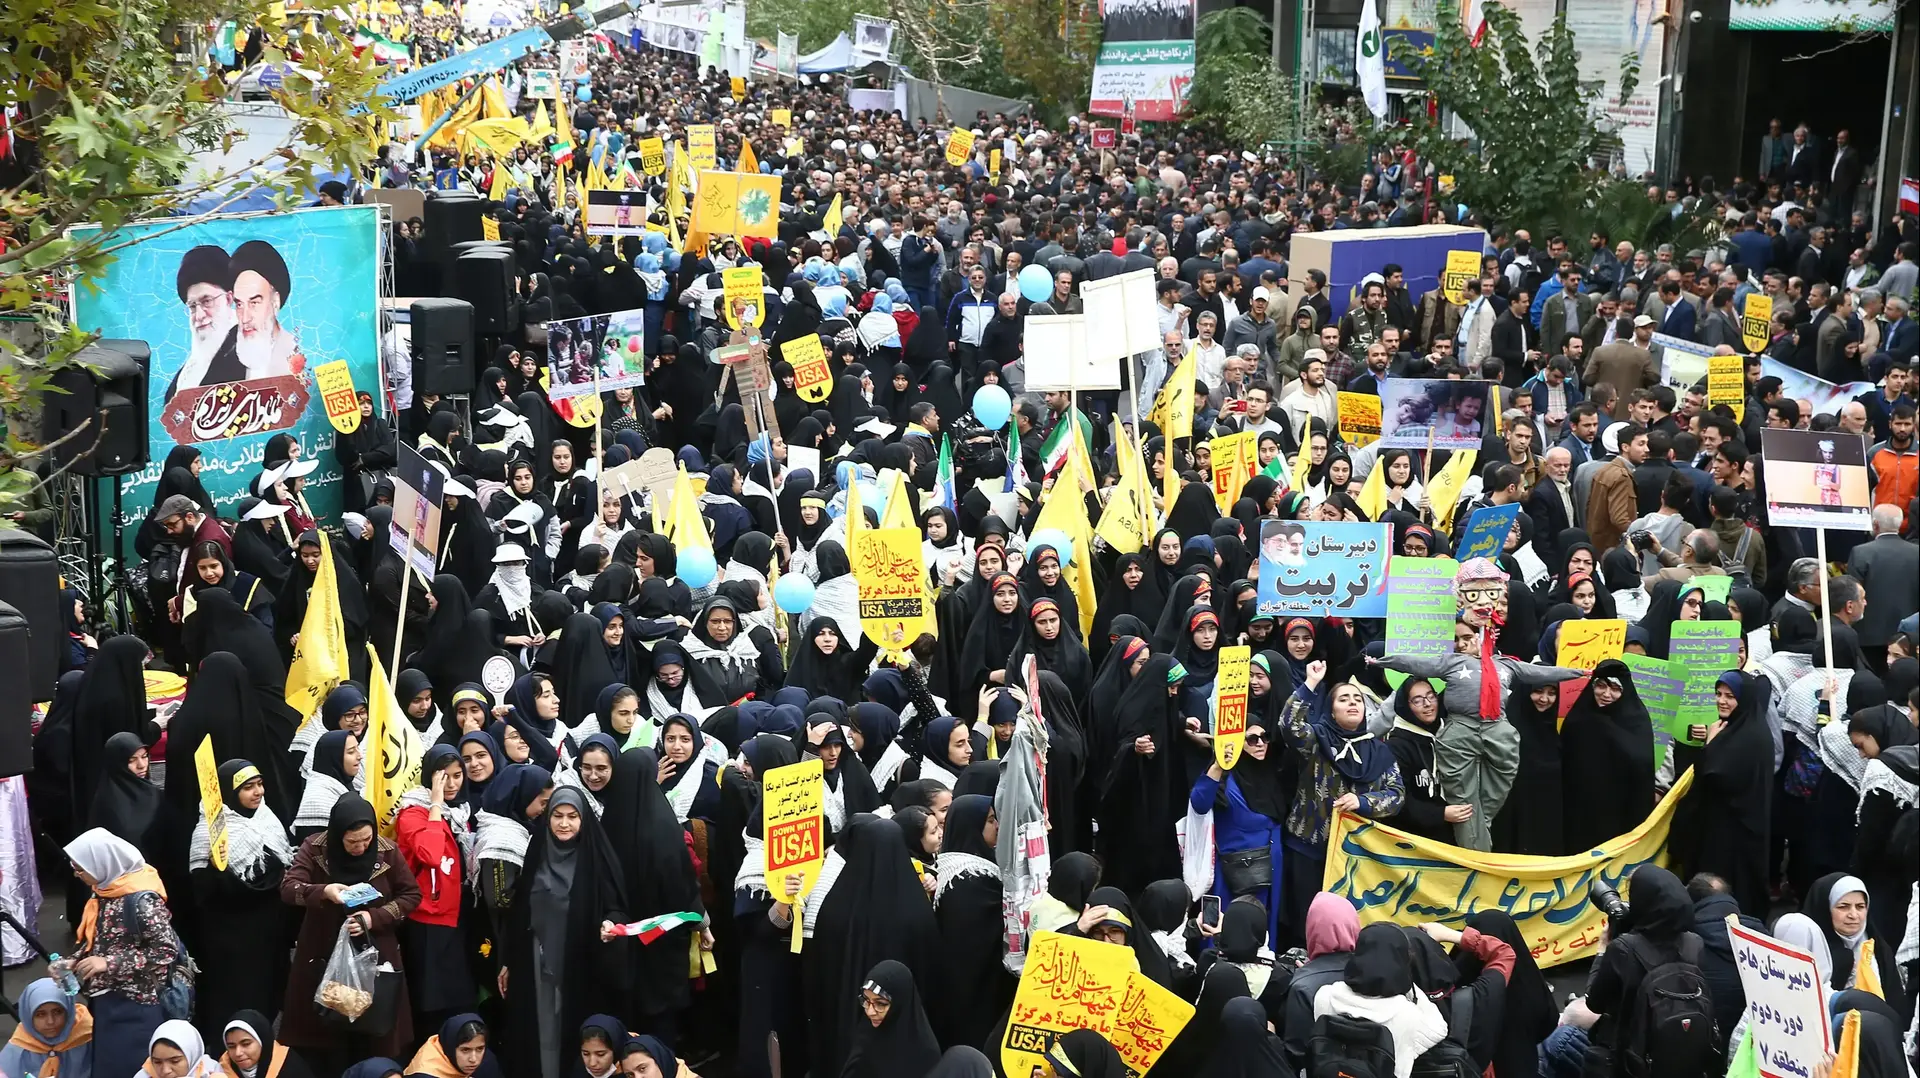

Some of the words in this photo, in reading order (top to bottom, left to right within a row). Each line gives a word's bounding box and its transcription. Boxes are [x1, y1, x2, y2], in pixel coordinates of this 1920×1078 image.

[645, 154, 663, 167] USA
[1448, 277, 1463, 290] US
[1745, 322, 1766, 338] USA
[796, 366, 827, 386] USA
[329, 395, 357, 415] USA
[1171, 411, 1183, 421] SA
[307, 431, 336, 459] انش
[219, 443, 265, 475] قلابی،
[1306, 535, 1377, 558] دبیرستان
[859, 585, 883, 599] هرگز!
[907, 588, 913, 597] و
[913, 583, 921, 594] ما
[1276, 563, 1370, 608] تربیت
[861, 604, 886, 617] USA
[1260, 601, 1281, 613] تهران
[1290, 601, 1311, 610] منطقه
[1220, 705, 1242, 732] USA
[765, 778, 785, 793] آمریکا
[806, 772, 822, 784] جواب
[777, 792, 793, 807] کشور
[793, 790, 803, 803] این
[768, 810, 782, 821] است
[782, 807, 796, 820] تغییر
[795, 804, 808, 816] قابل
[808, 802, 818, 814] غیر
[773, 824, 796, 838] DOWN
[796, 819, 816, 833] WITH
[772, 829, 816, 866] USA
[1738, 946, 1759, 971] هاج
[1759, 954, 1813, 991] دبیرستان
[1015, 1003, 1053, 1025] هرگز!
[1751, 1000, 1773, 1026] دوم
[1099, 1019, 1112, 1034] ما
[1773, 1009, 1804, 1037] دوره
[1014, 1025, 1034, 1035] DOWN
[1034, 1029, 1051, 1038] WITH
[1010, 1031, 1046, 1053] USA
[1128, 1055, 1140, 1064] و
[1758, 1040, 1769, 1066] ۷
[1139, 1055, 1151, 1069] ما
[1772, 1048, 1810, 1078] منطقه
